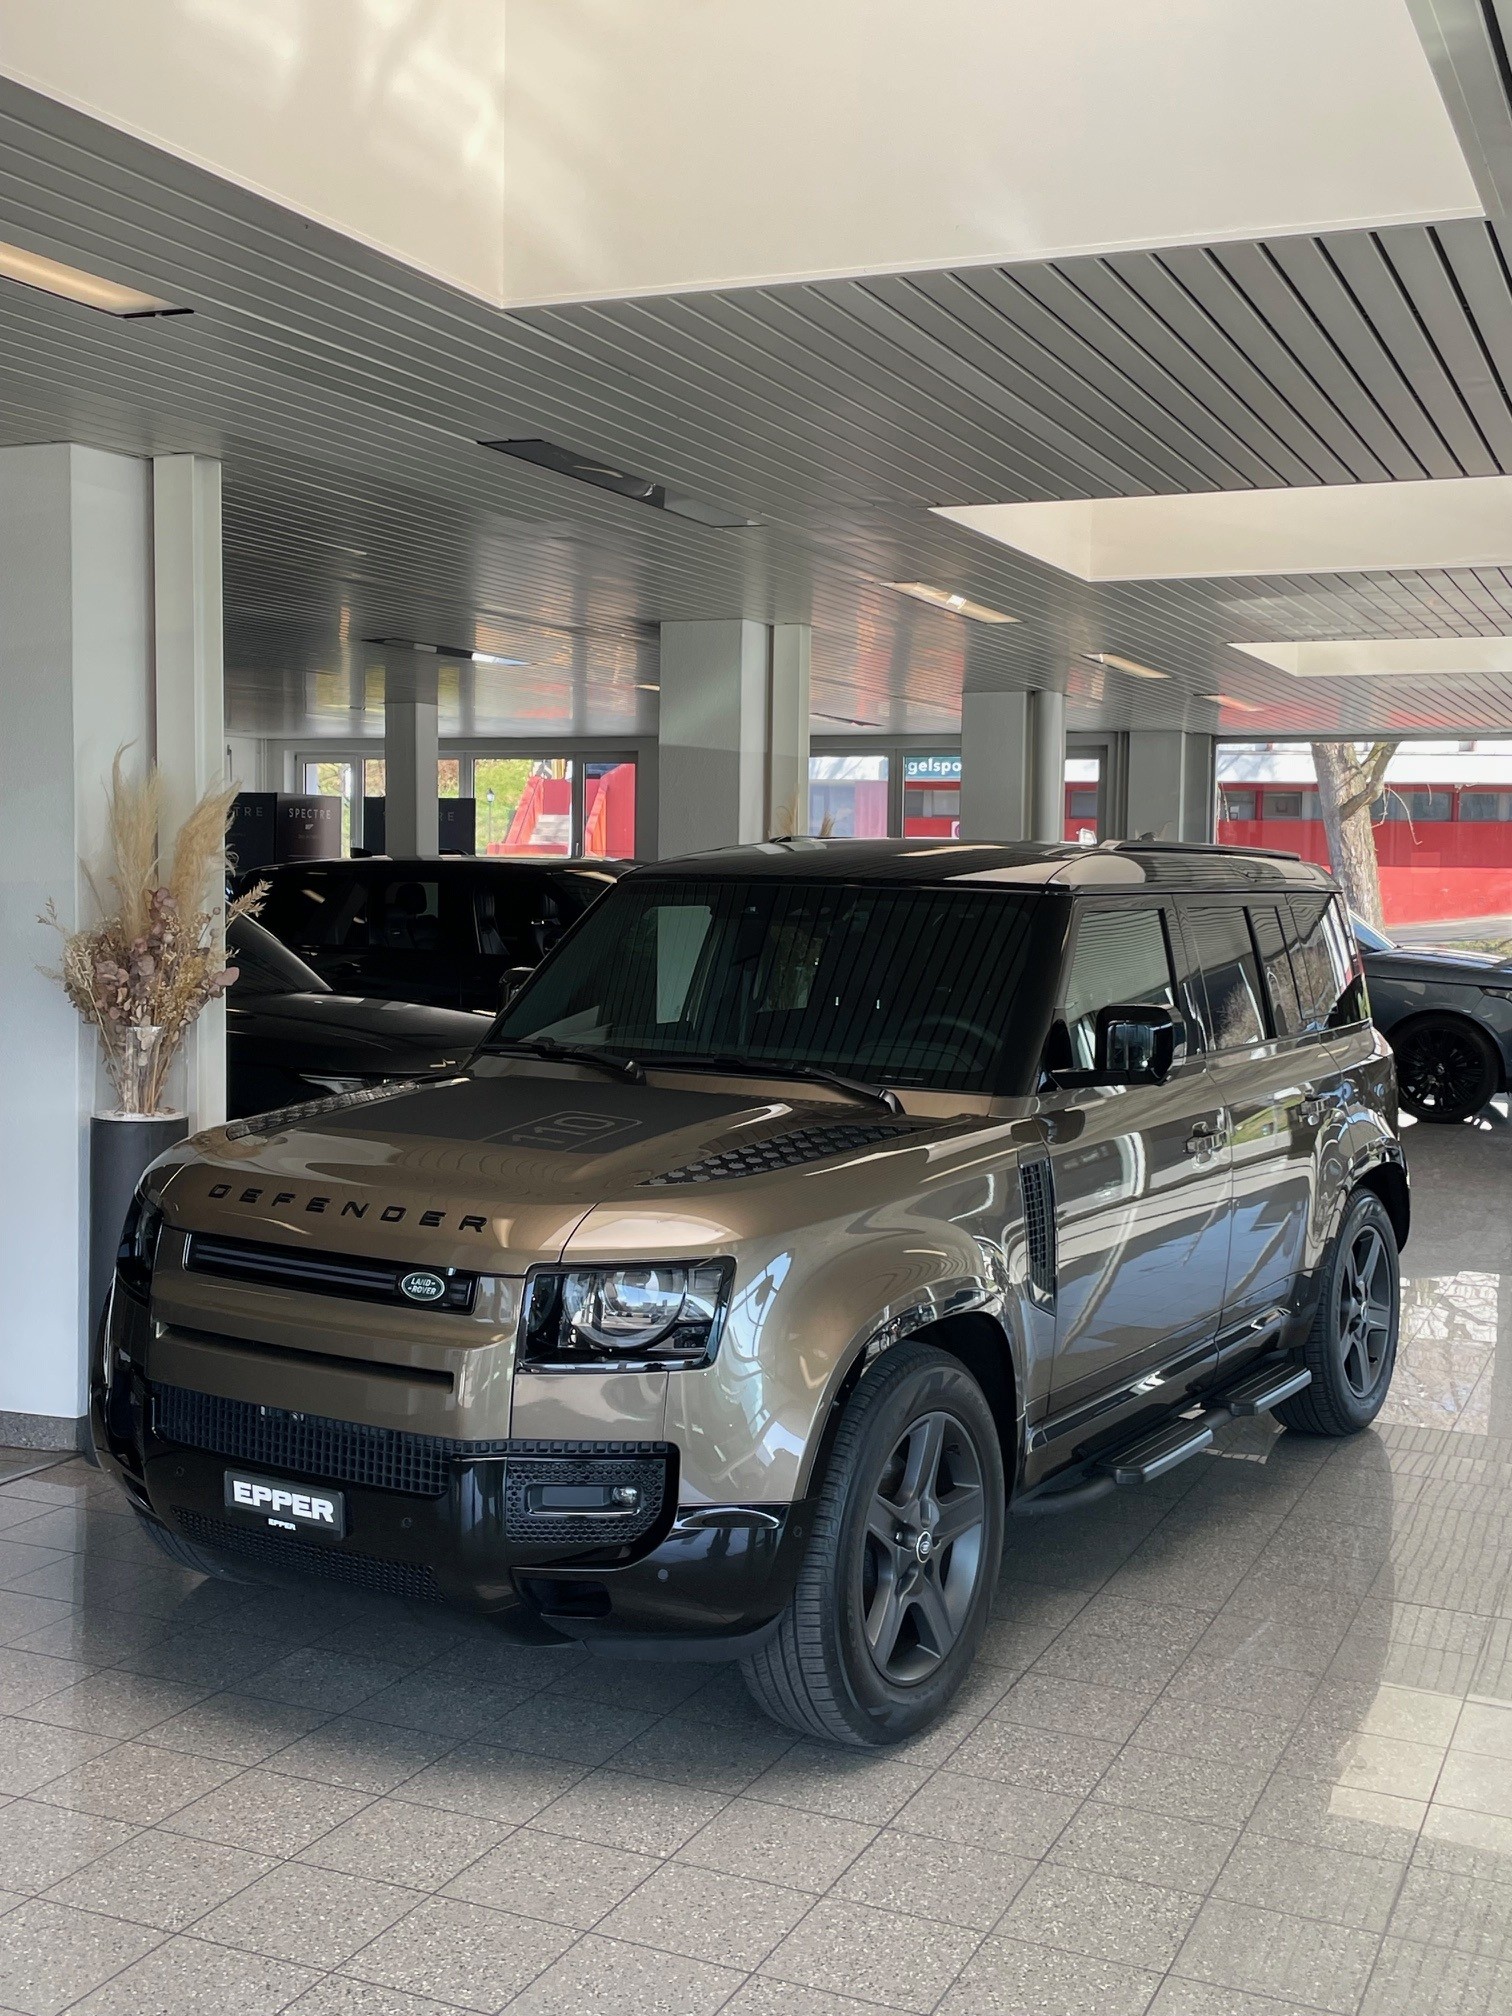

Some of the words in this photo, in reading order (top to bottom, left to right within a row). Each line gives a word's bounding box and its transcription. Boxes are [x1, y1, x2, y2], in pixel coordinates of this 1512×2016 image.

[907, 757, 962, 775] gelspo
[234, 806, 263, 817] TRE
[288, 808, 332, 820] SPECTRE
[512, 1116, 615, 1144] 110
[208, 1183, 488, 1233] DEFENDER
[232, 1480, 334, 1523] EPPER
[267, 1517, 297, 1531] EPPER
